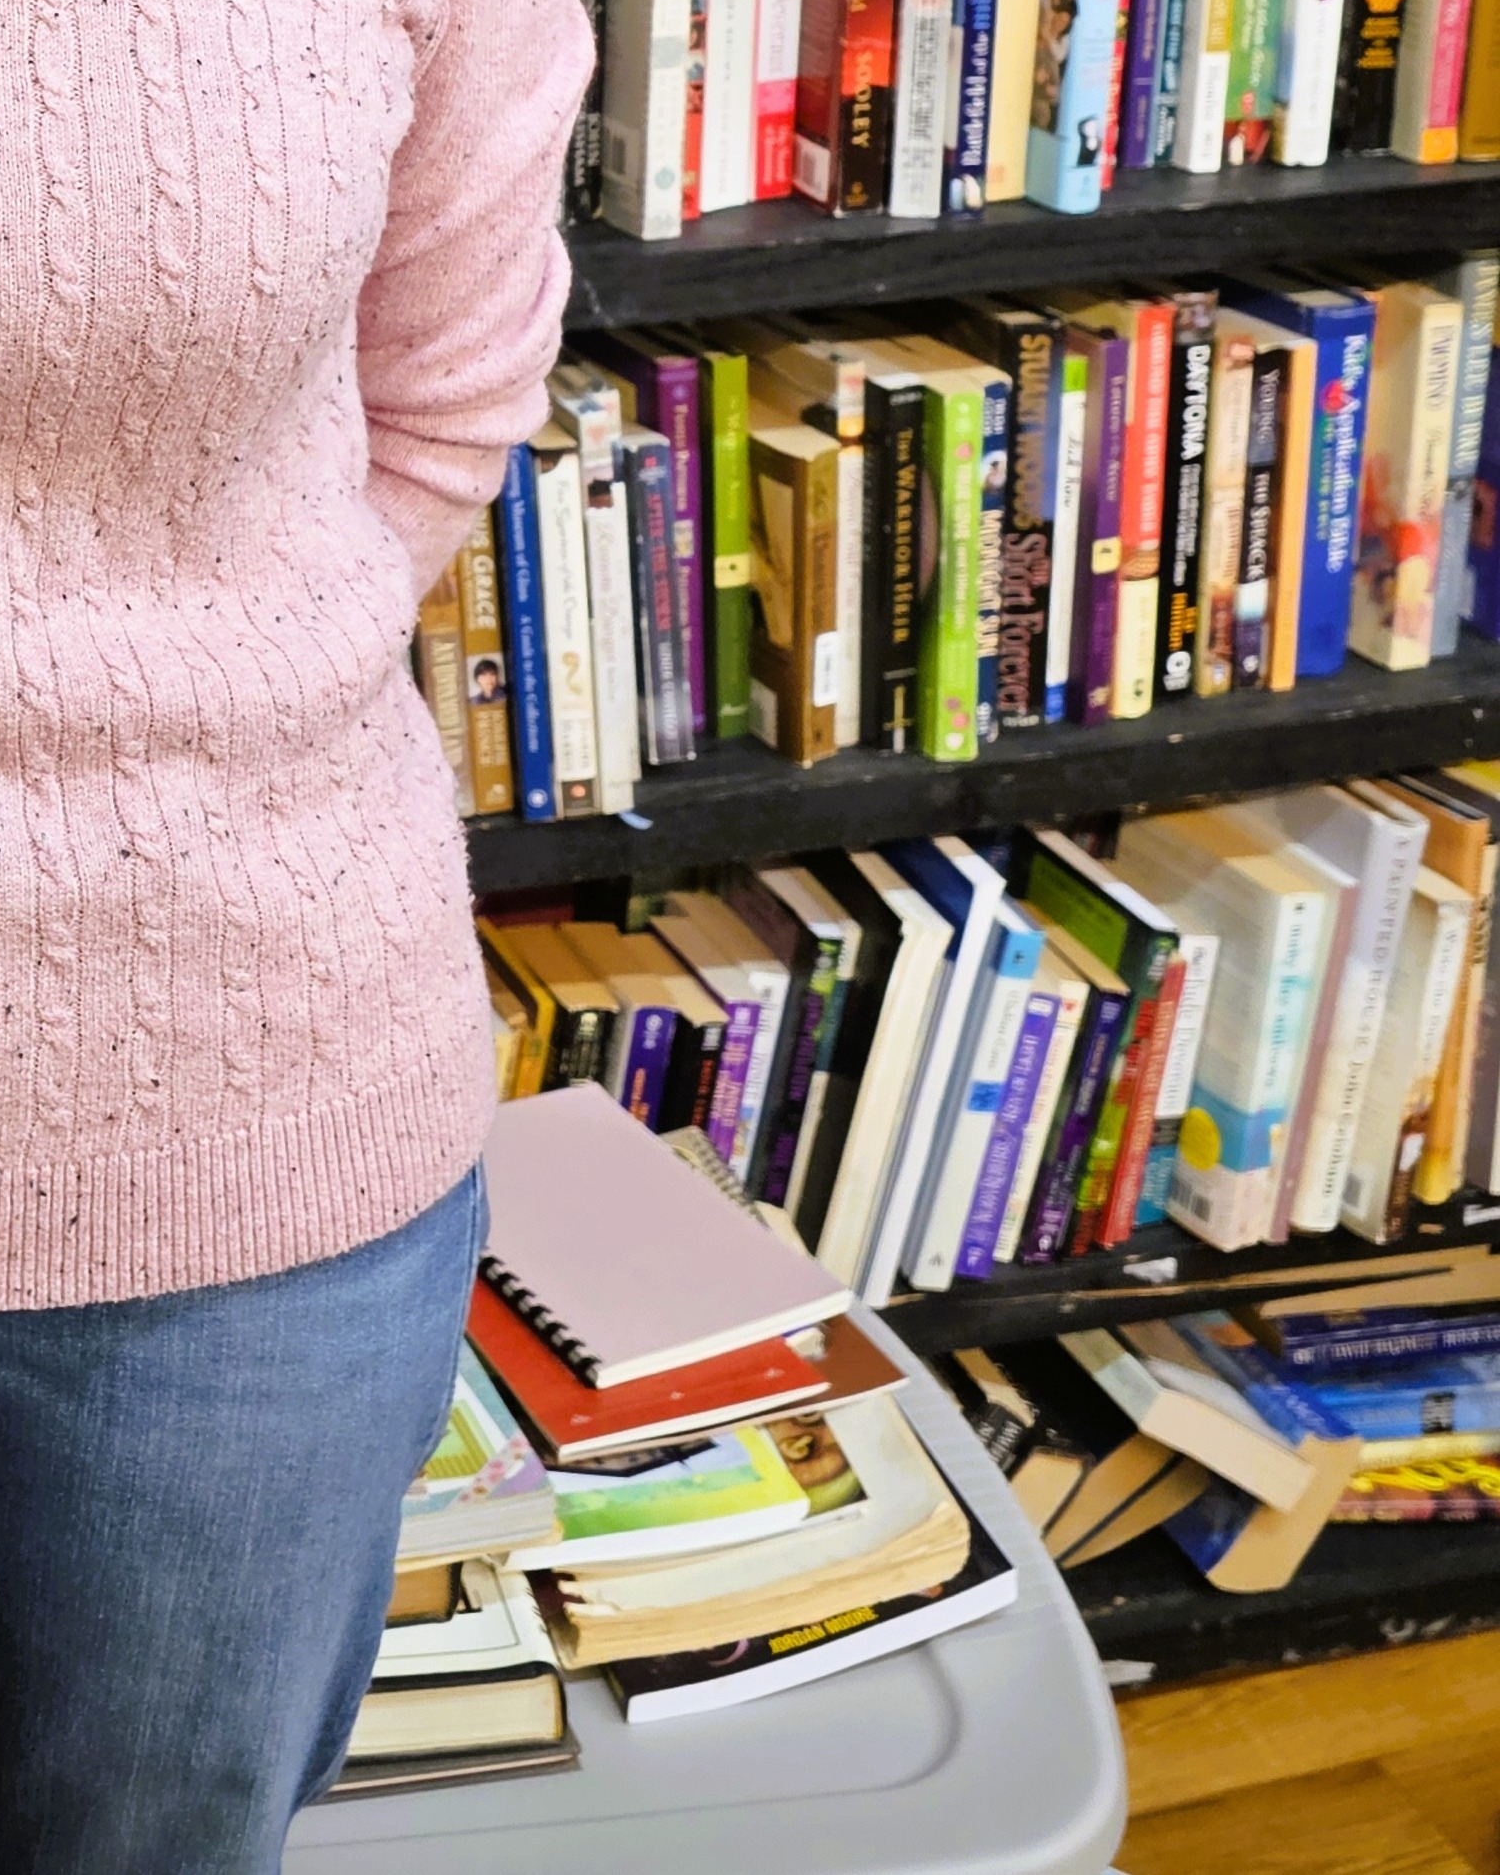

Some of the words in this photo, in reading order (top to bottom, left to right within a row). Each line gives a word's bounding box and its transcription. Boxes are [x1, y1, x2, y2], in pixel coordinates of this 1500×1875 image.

[1018, 333, 1051, 424] STUART
[1181, 343, 1211, 459] DAYTONA
[895, 429, 914, 463] THE
[1013, 428, 1046, 528] WOODS
[1331, 393, 1363, 513] Application
[511, 500, 529, 552] Museum
[893, 463, 917, 581] WARRIOR
[1246, 505, 1271, 579] SHACK
[1325, 516, 1350, 575] Bible
[474, 554, 498, 631] GRACE
[515, 569, 531, 603] Glass
[1003, 532, 1048, 605] Short
[893, 582, 915, 645] HEIR
[977, 615, 1001, 658] SUN
[999, 610, 1046, 716] Forever
[1373, 856, 1405, 962] PAINTED
